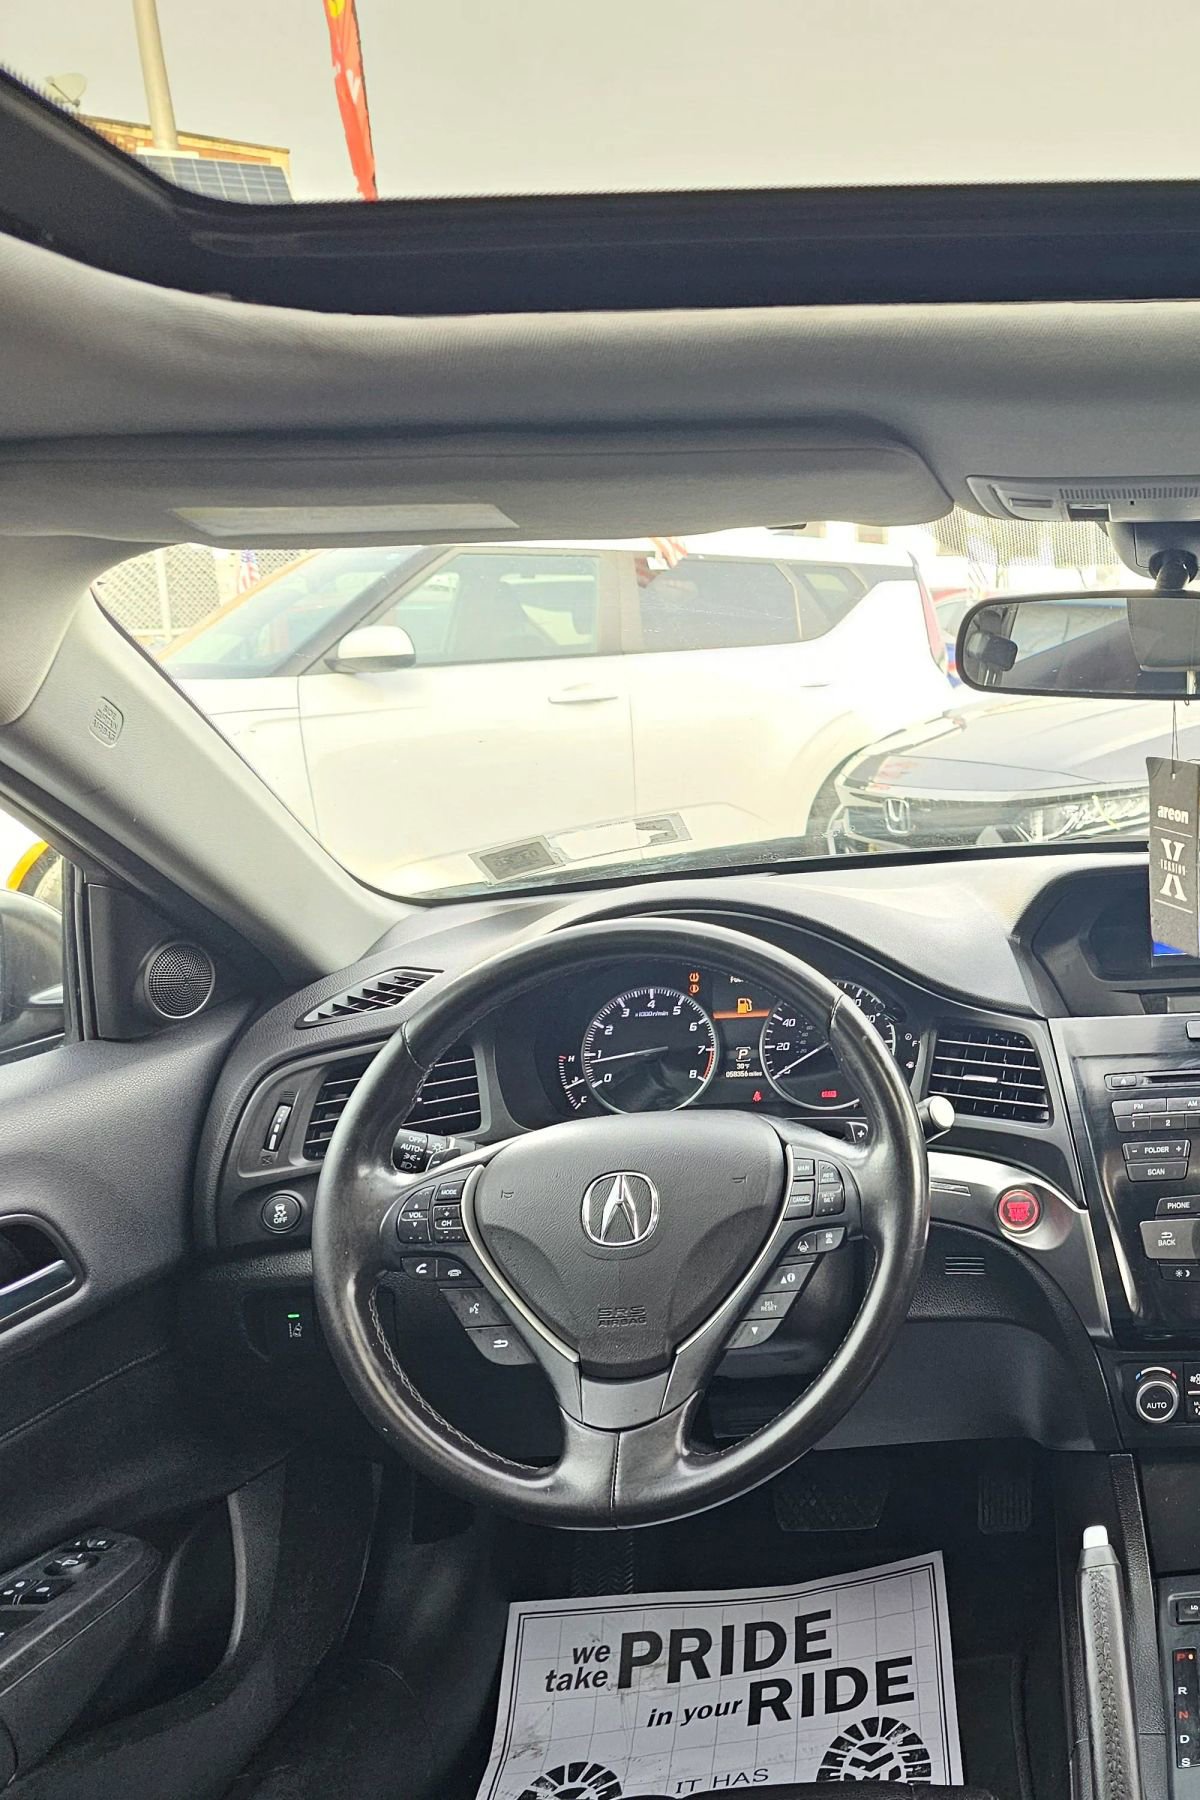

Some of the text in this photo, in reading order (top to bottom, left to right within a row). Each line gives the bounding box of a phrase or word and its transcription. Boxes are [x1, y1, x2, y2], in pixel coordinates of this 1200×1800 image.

[1157, 805, 1189, 825] areon
[621, 1008, 630, 1018] 3
[689, 1022, 698, 1032] 6
[782, 1018, 796, 1028] 40
[604, 1025, 614, 1036] 2
[776, 1042, 791, 1051] 20
[689, 1069, 697, 1079] 8
[1144, 1145, 1170, 1154] FOLDER
[1147, 1168, 1165, 1176] SCAN
[1167, 1202, 1191, 1210] PHONE
[1157, 1238, 1176, 1247] BACK
[1146, 1401, 1168, 1410] AUTO
[571, 1642, 611, 1665] we
[617, 1609, 832, 1690] PRIDE
[1176, 1654, 1186, 1662] P
[545, 1667, 609, 1693] take
[647, 1655, 915, 1728] in your RIDE
[1178, 1686, 1188, 1695] R
[1179, 1711, 1189, 1719] N
[1180, 1735, 1190, 1744] D
[1181, 1758, 1190, 1766] S
[675, 1768, 769, 1794] IT HAS
